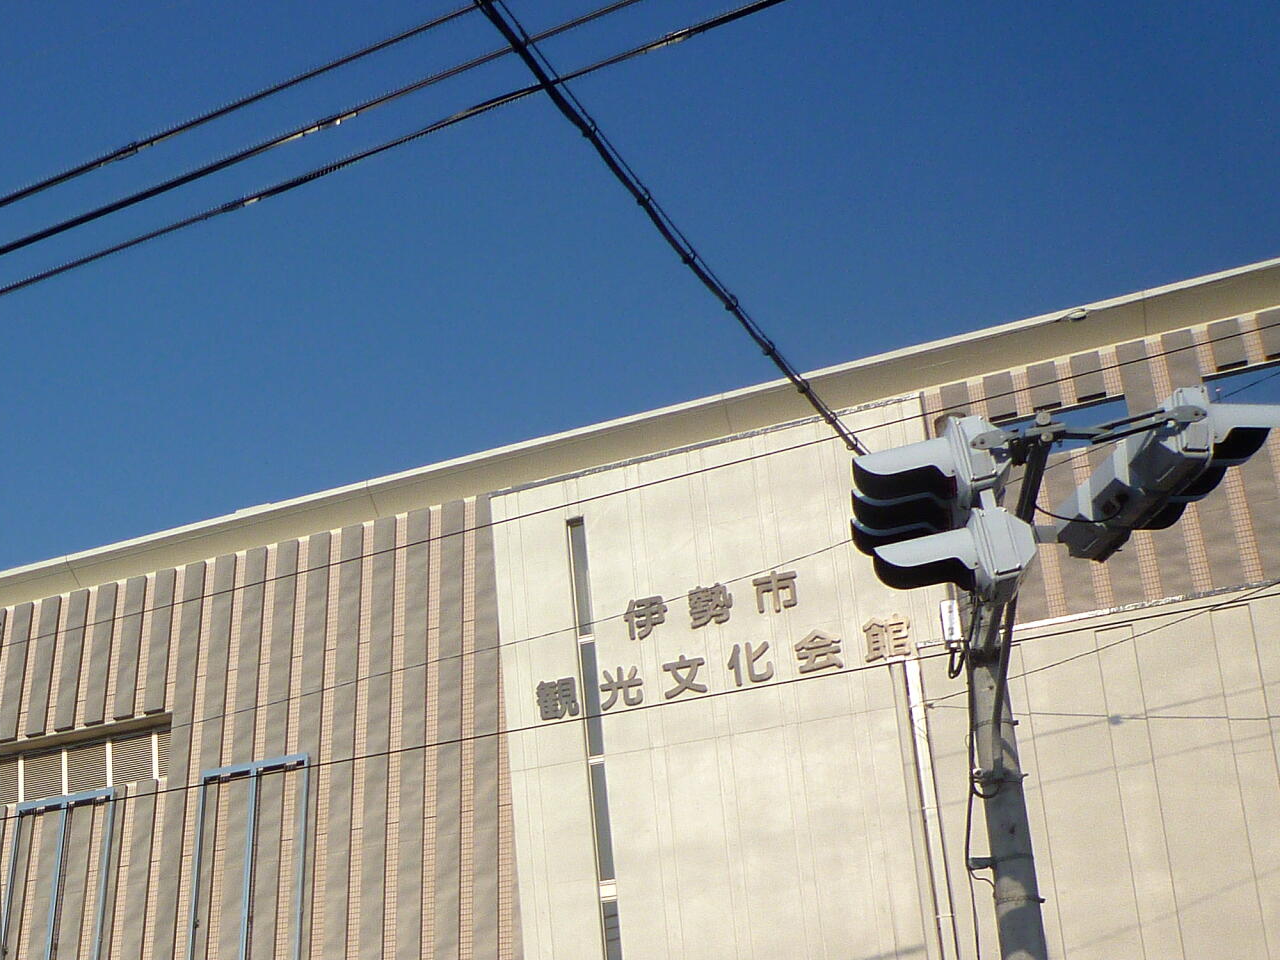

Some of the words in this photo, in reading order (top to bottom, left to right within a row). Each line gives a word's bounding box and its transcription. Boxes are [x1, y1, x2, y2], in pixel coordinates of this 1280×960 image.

[623, 569, 797, 641] 伊勢市
[535, 612, 912, 721] 観光文化会館
